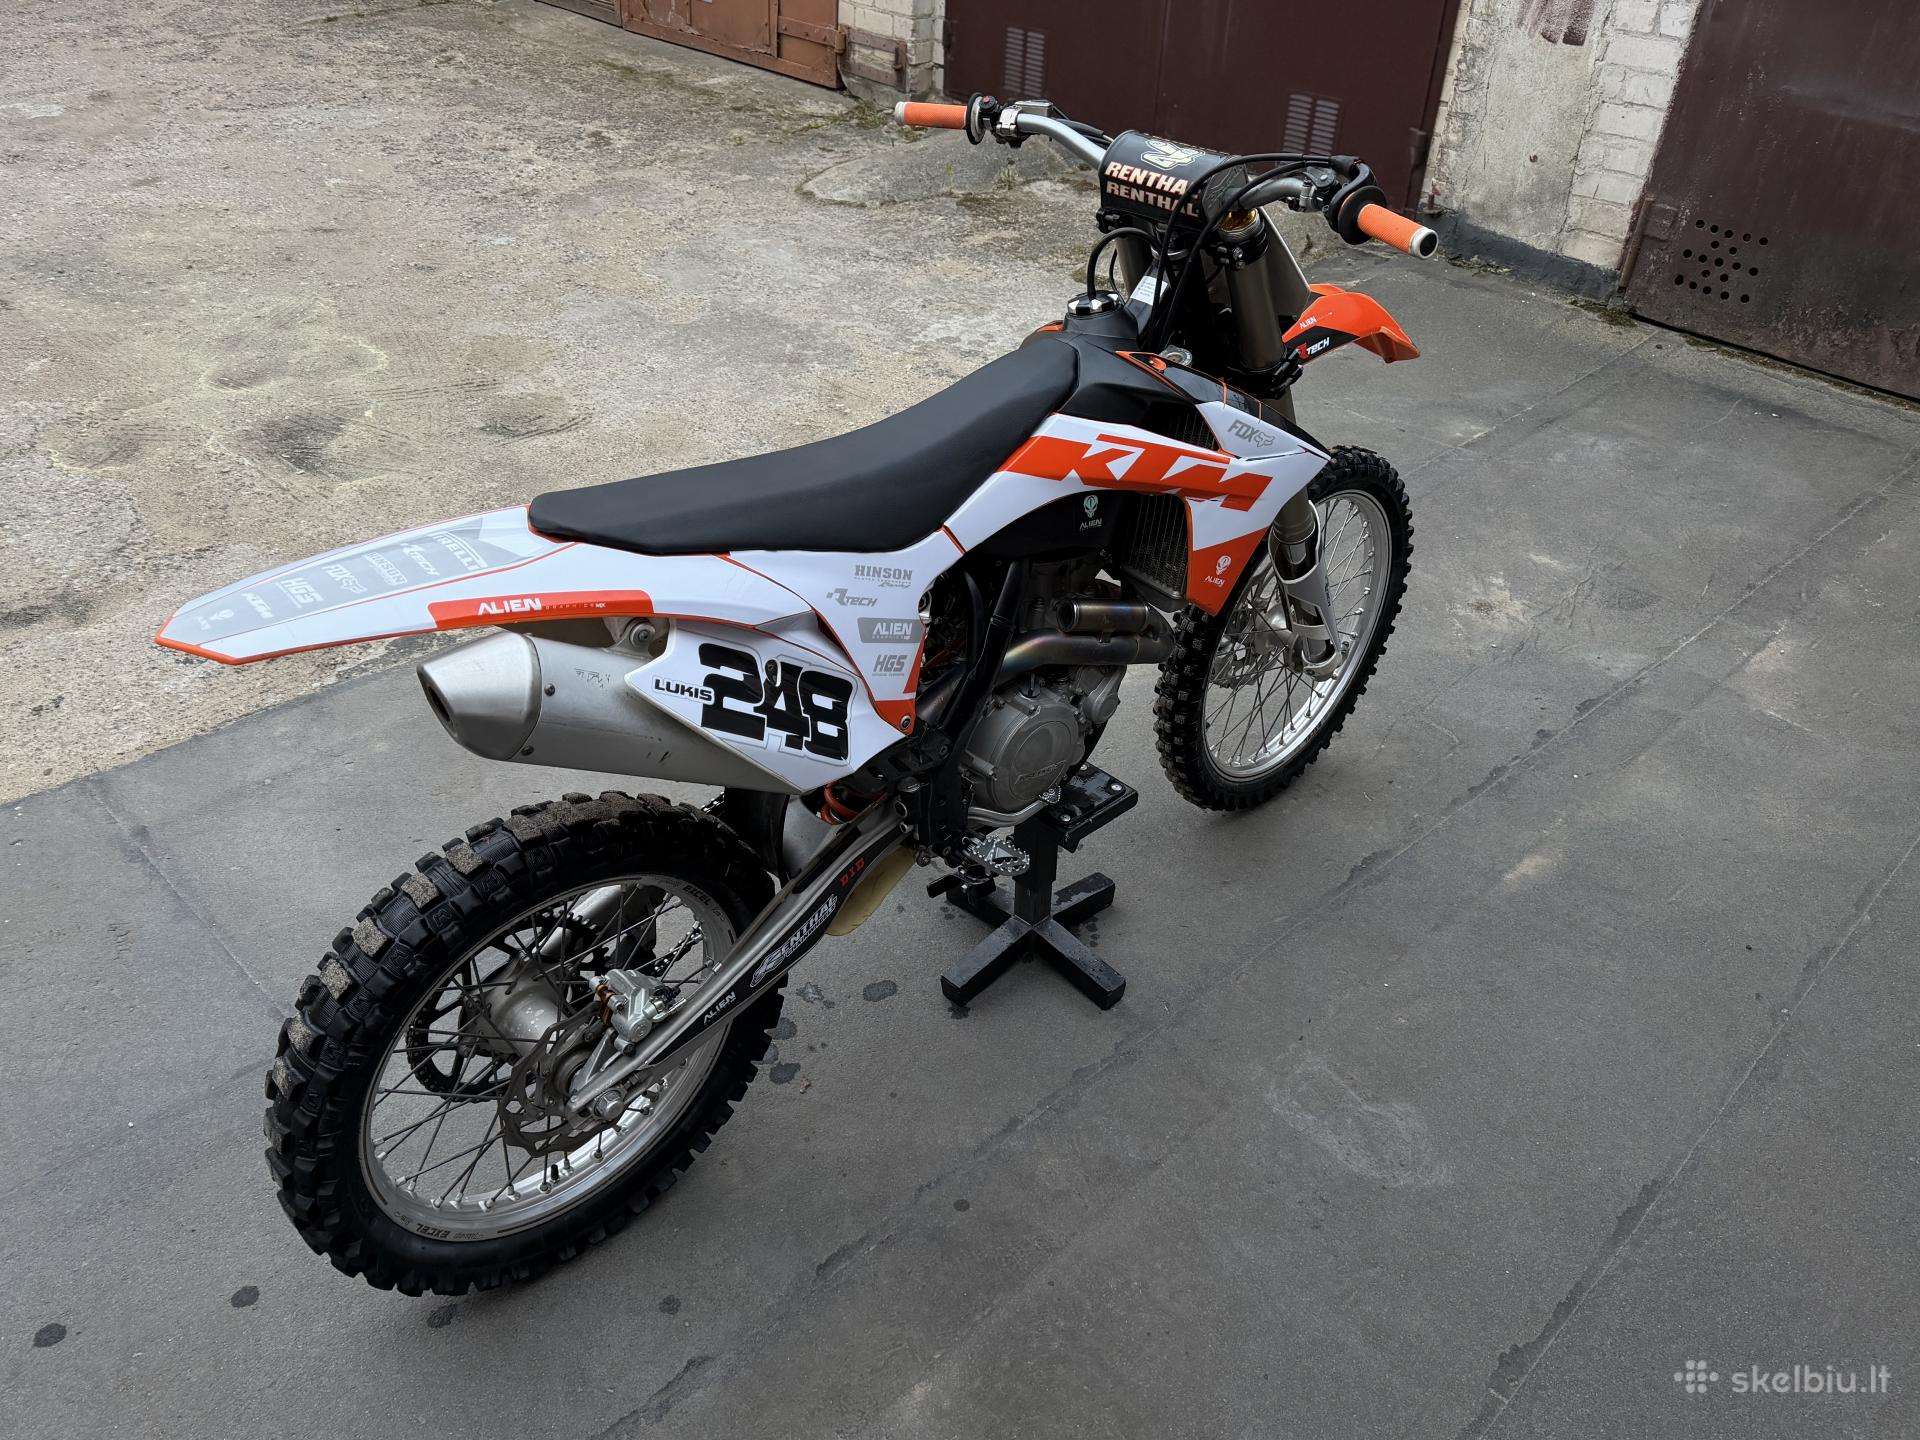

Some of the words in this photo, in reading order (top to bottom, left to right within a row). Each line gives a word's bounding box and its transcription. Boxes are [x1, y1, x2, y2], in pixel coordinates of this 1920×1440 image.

[1104, 161, 1201, 199] RENTHA
[1227, 419, 1260, 443] FOX
[996, 433, 1273, 512] KTM
[854, 564, 913, 581] HINSON
[281, 577, 324, 604] HGS
[478, 597, 542, 615] ALIEN
[873, 622, 912, 635] ALIEN
[873, 654, 909, 673] HGS
[654, 678, 713, 702] LUKIS
[698, 642, 854, 761] 248
[682, 885, 711, 906] EXCEL
[703, 991, 736, 1023] ALIEN
[416, 1223, 451, 1239] EXCEL
